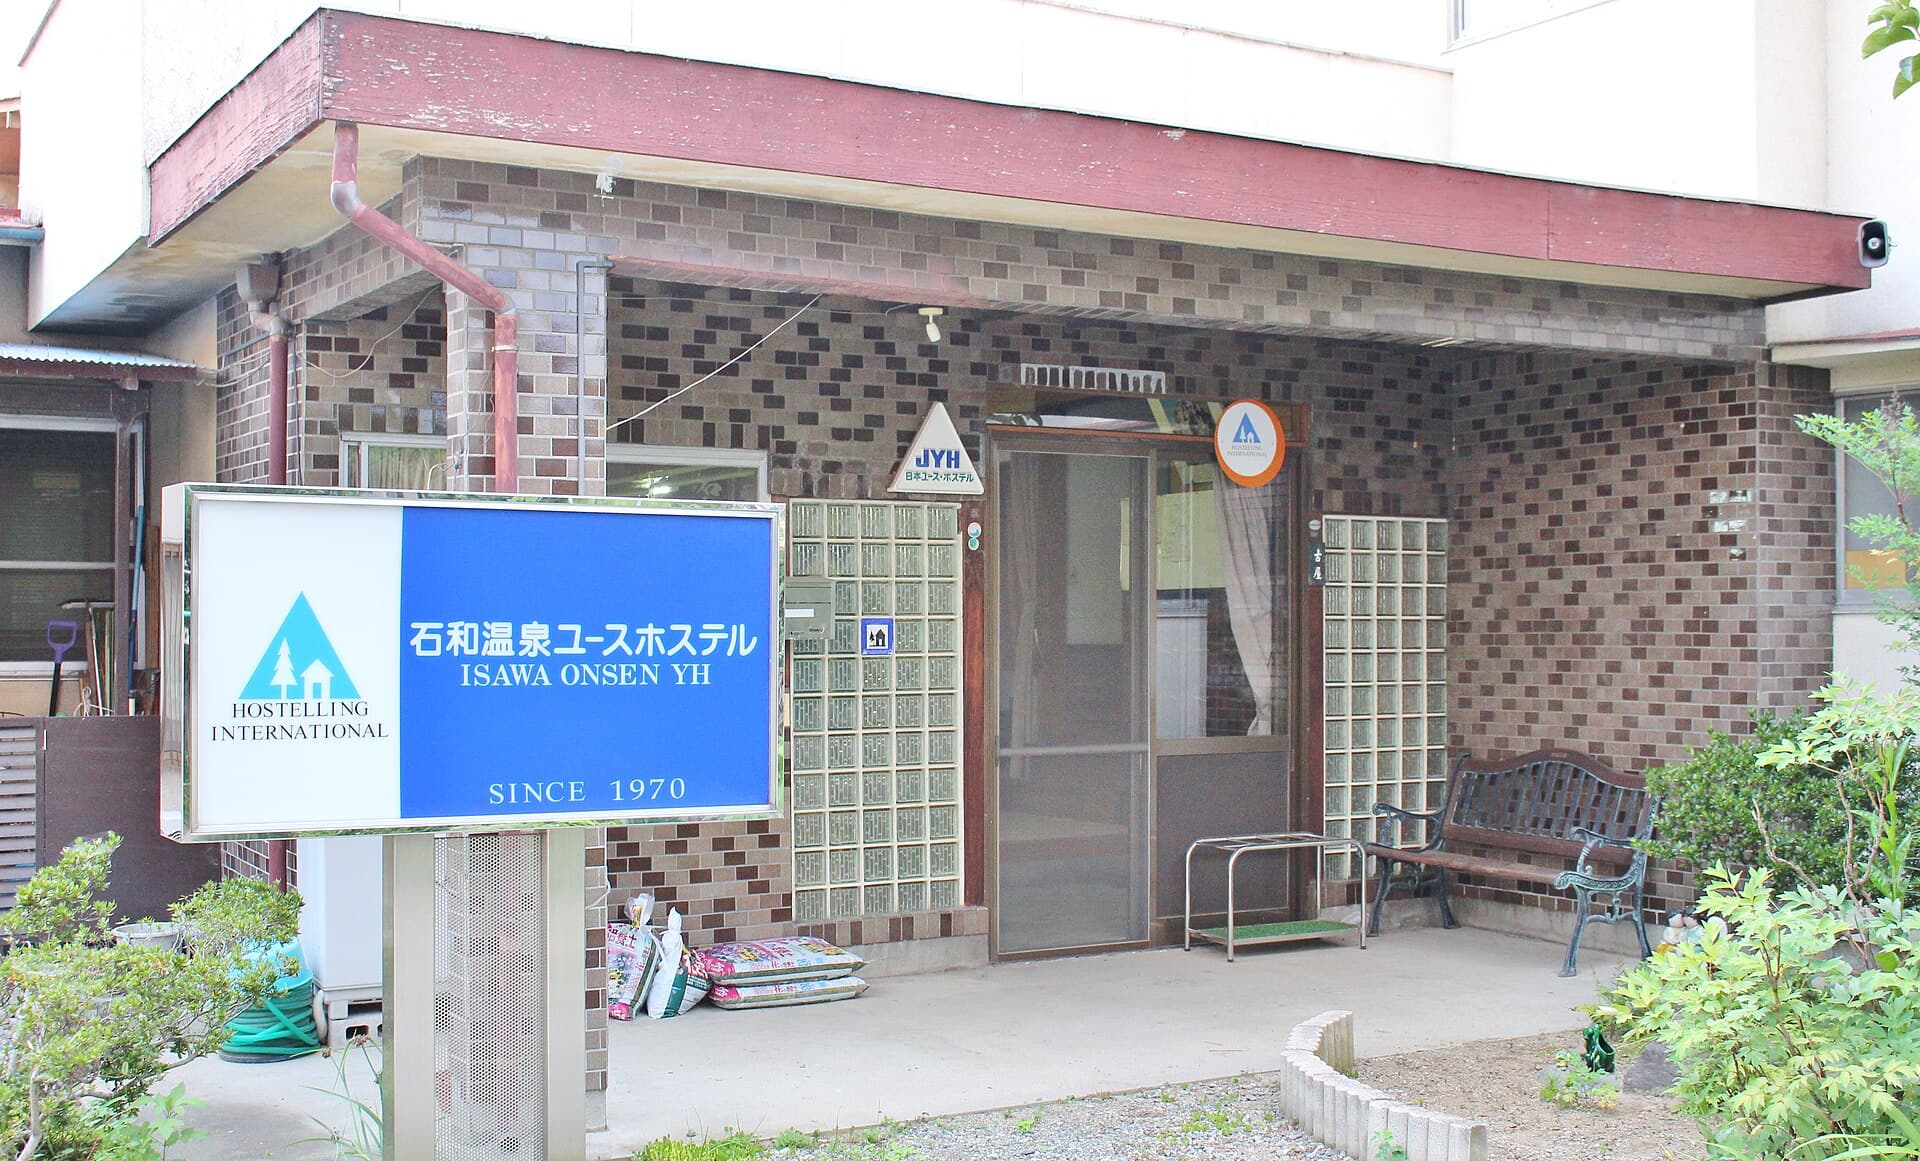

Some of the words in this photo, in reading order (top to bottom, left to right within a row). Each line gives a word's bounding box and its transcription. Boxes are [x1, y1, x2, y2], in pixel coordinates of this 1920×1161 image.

[915, 449, 960, 469] JYH
[905, 471, 974, 483] 日本ユース・ホステル
[409, 620, 759, 658] 石和温泉ユースホステル
[460, 663, 552, 687] ISAWA
[560, 663, 660, 686] ONSEN
[670, 663, 712, 686] YH
[232, 701, 369, 719] HOSTELLING
[211, 723, 389, 742] INTERNATIONAL
[488, 781, 586, 805] SINCE
[609, 777, 687, 801] 1970
